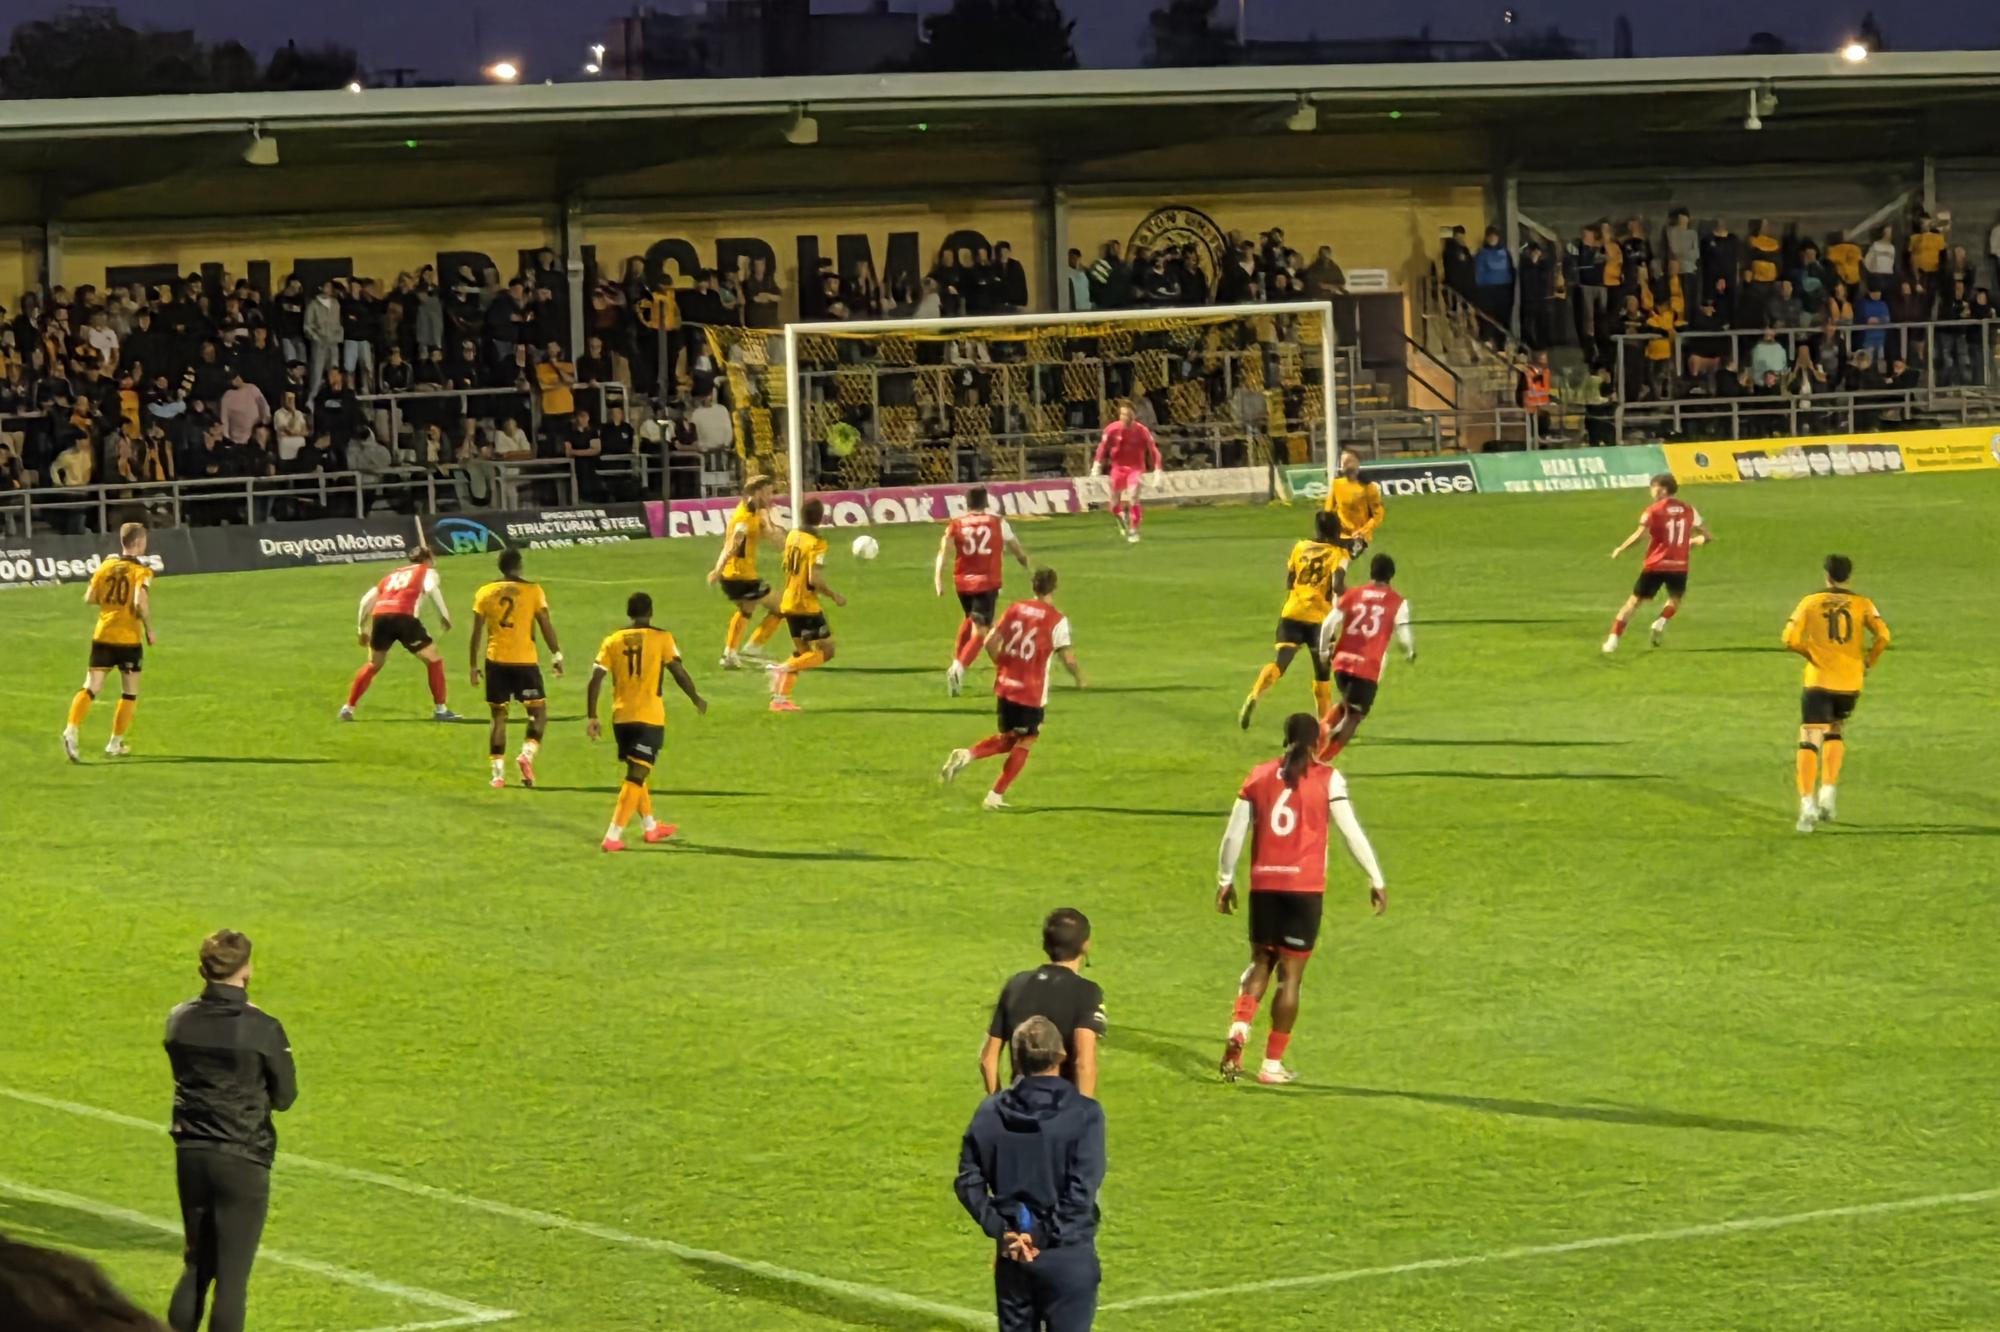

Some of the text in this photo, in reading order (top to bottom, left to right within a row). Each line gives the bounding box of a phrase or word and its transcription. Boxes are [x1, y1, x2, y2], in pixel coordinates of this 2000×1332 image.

[506, 516, 645, 537] STRUCTURAL STEEL
[961, 526, 992, 555] 32
[1665, 518, 1685, 546] 11
[259, 537, 338, 559] Drayton
[336, 533, 405, 552] Motors
[105, 575, 130, 605] 20
[499, 596, 514, 628] 2
[1346, 602, 1385, 637] 23
[1822, 608, 1852, 644] 10
[1005, 620, 1038, 661] 26
[1271, 788, 1295, 836] 6
